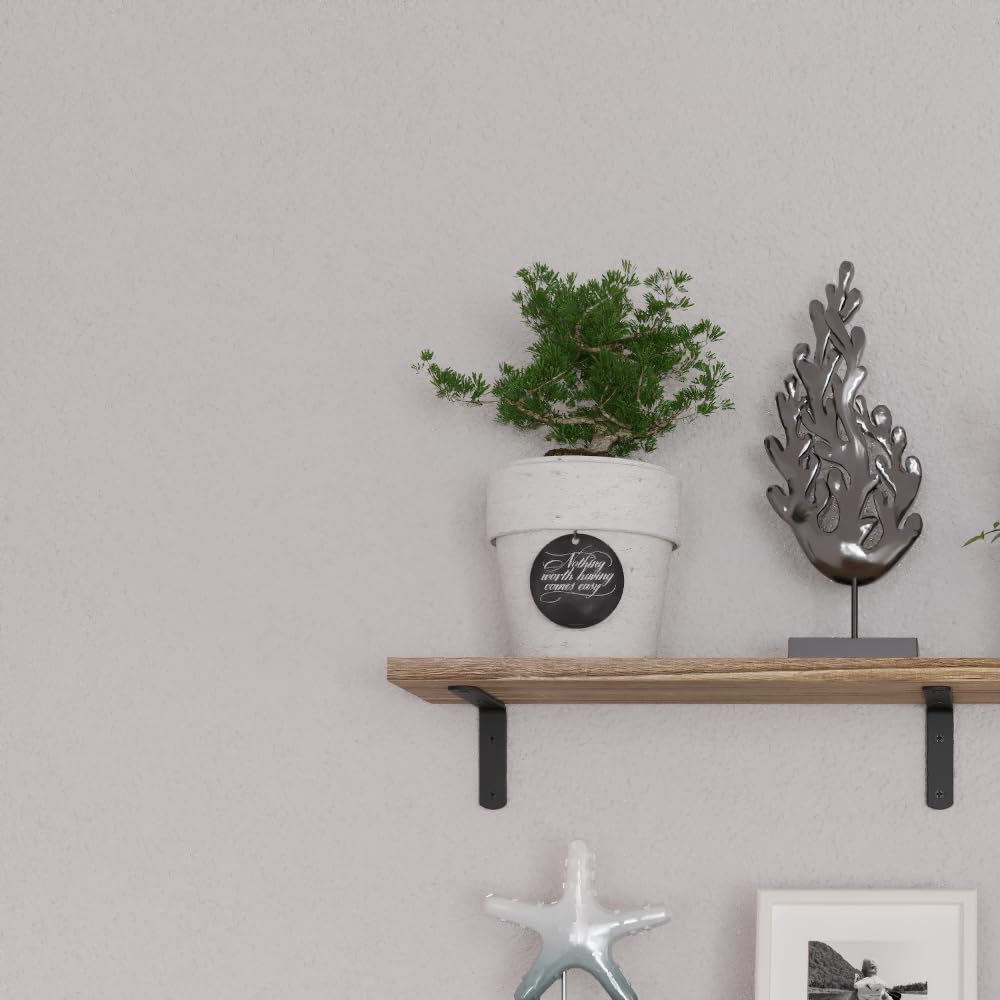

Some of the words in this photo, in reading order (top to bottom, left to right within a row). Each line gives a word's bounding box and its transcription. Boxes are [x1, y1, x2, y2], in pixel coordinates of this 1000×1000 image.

[540, 569, 575, 582] worth
[576, 566, 615, 587] having
[543, 583, 576, 591] comes
[577, 583, 602, 598] easy
